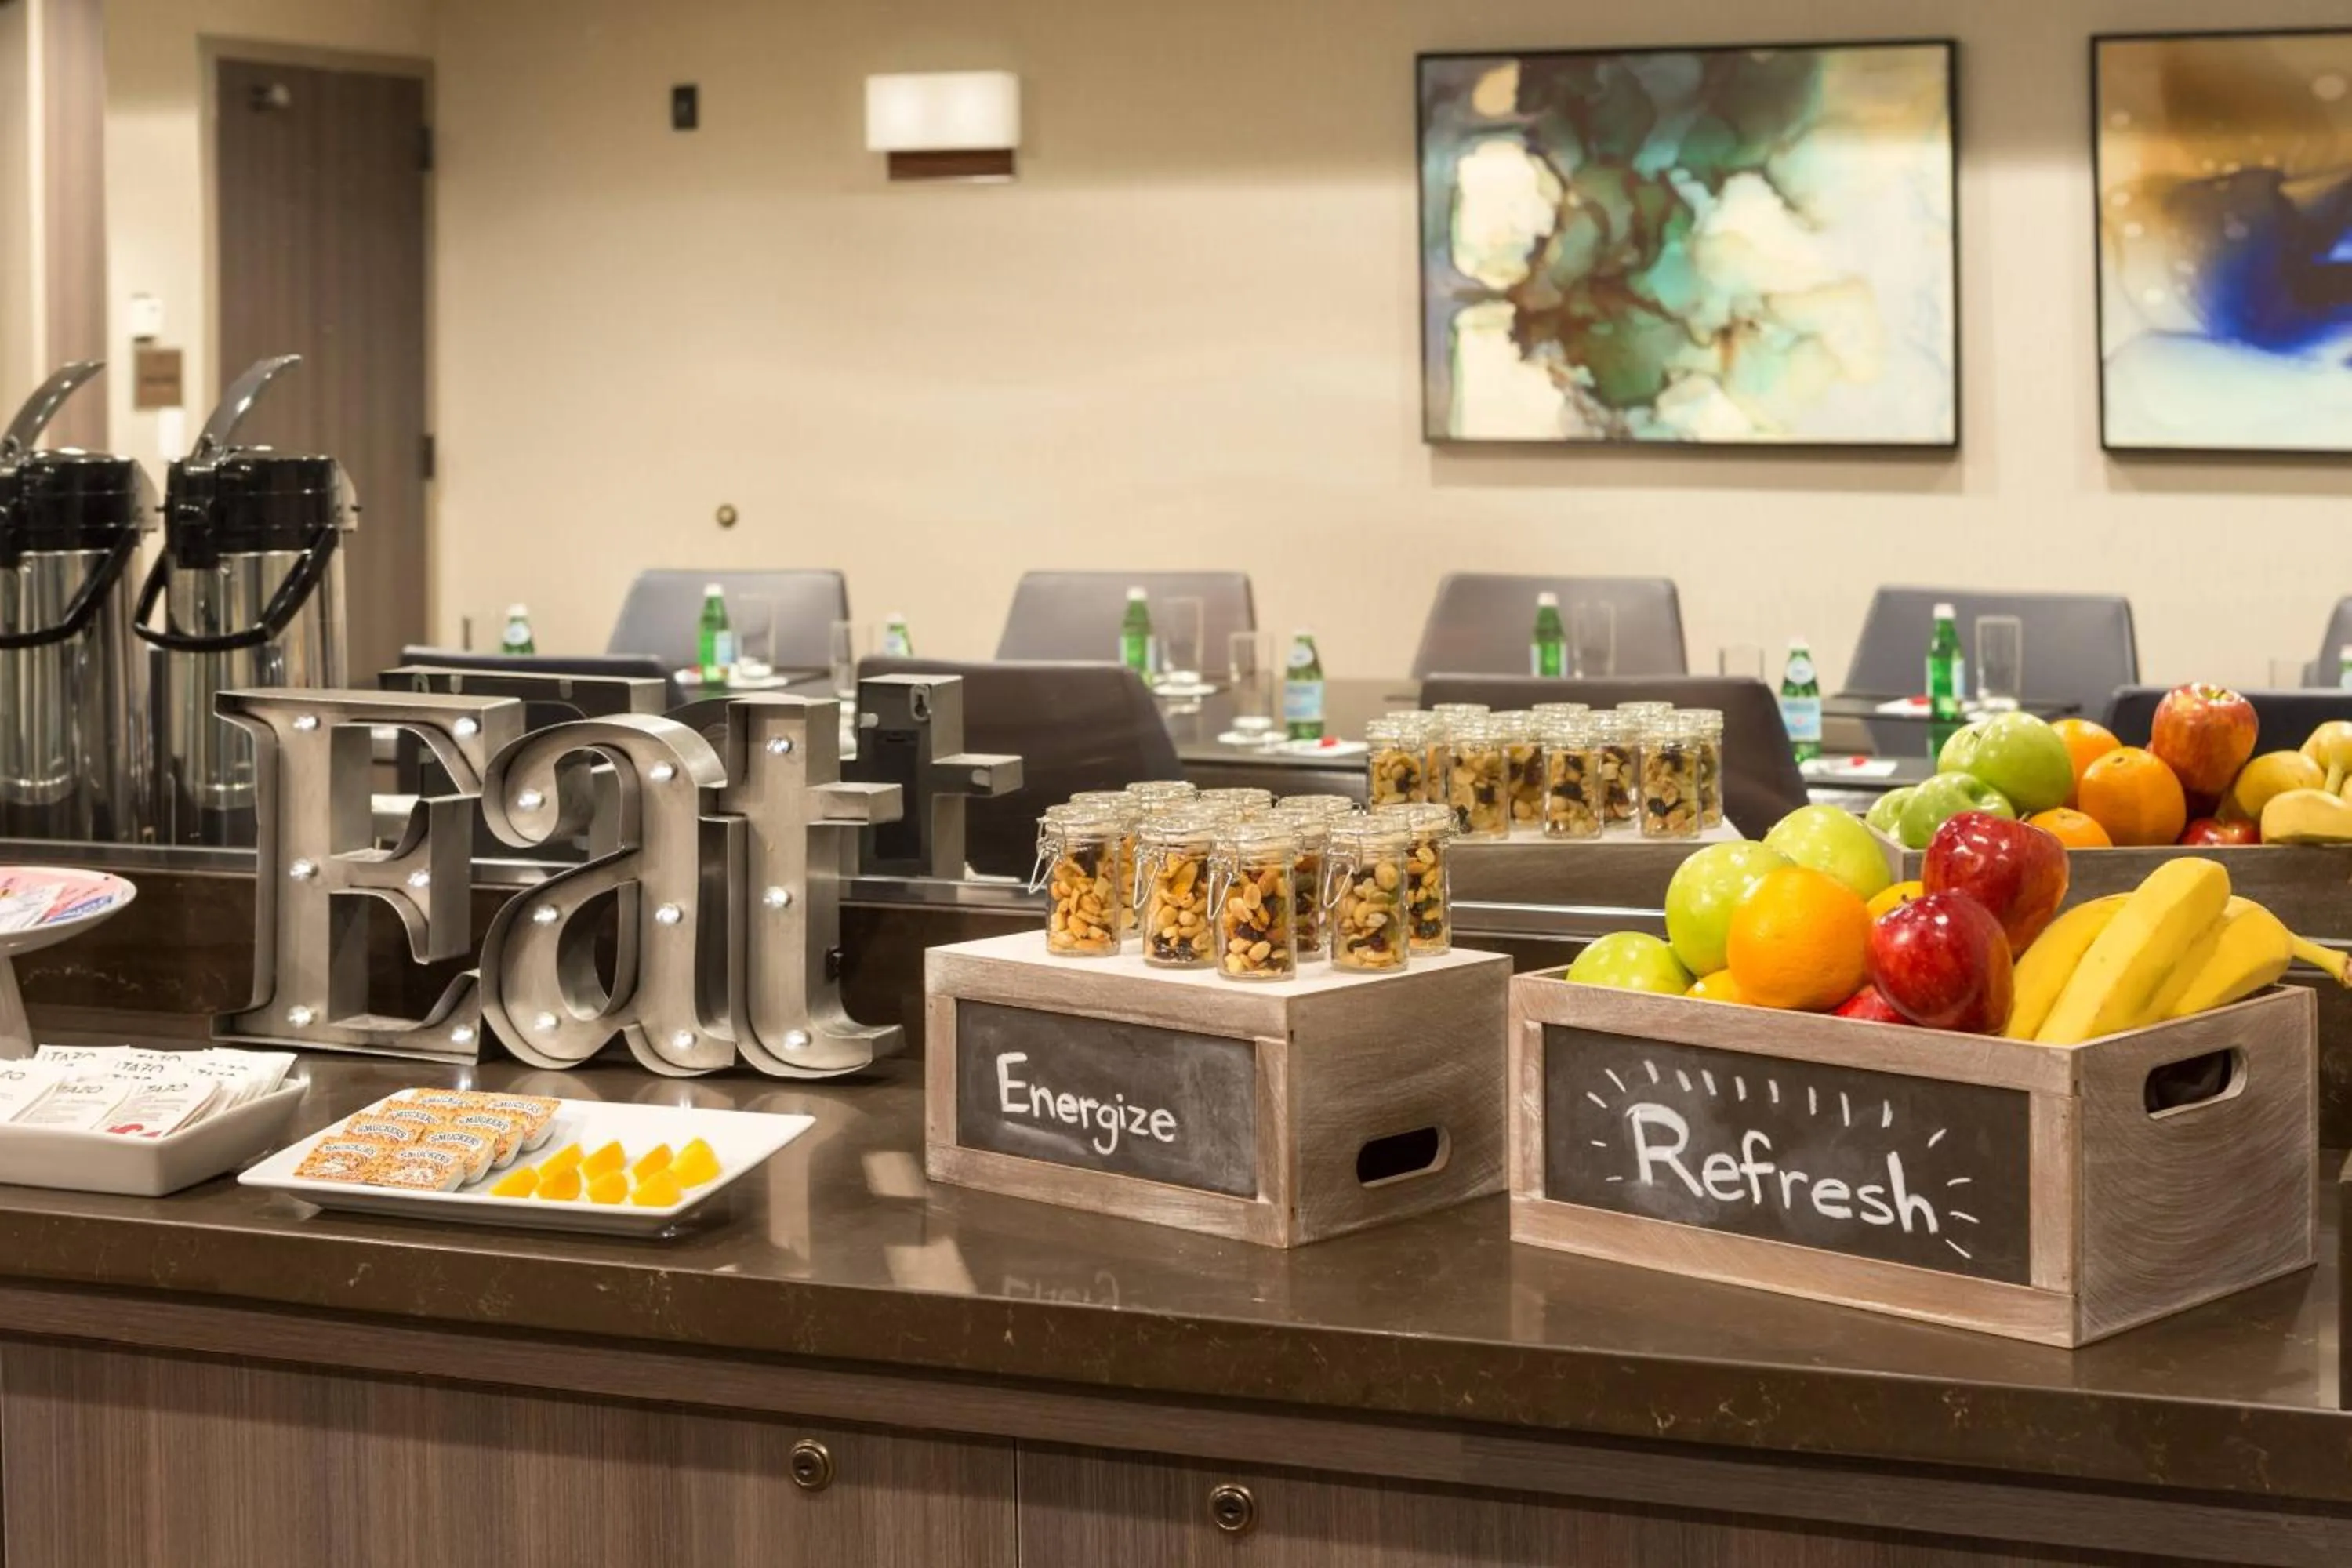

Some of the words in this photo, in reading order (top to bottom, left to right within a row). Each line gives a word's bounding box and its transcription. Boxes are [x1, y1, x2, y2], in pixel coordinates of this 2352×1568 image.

[210, 687, 905, 1079] Eat
[996, 1051, 1176, 1155] Energize
[1626, 1102, 1939, 1234] Refresh
